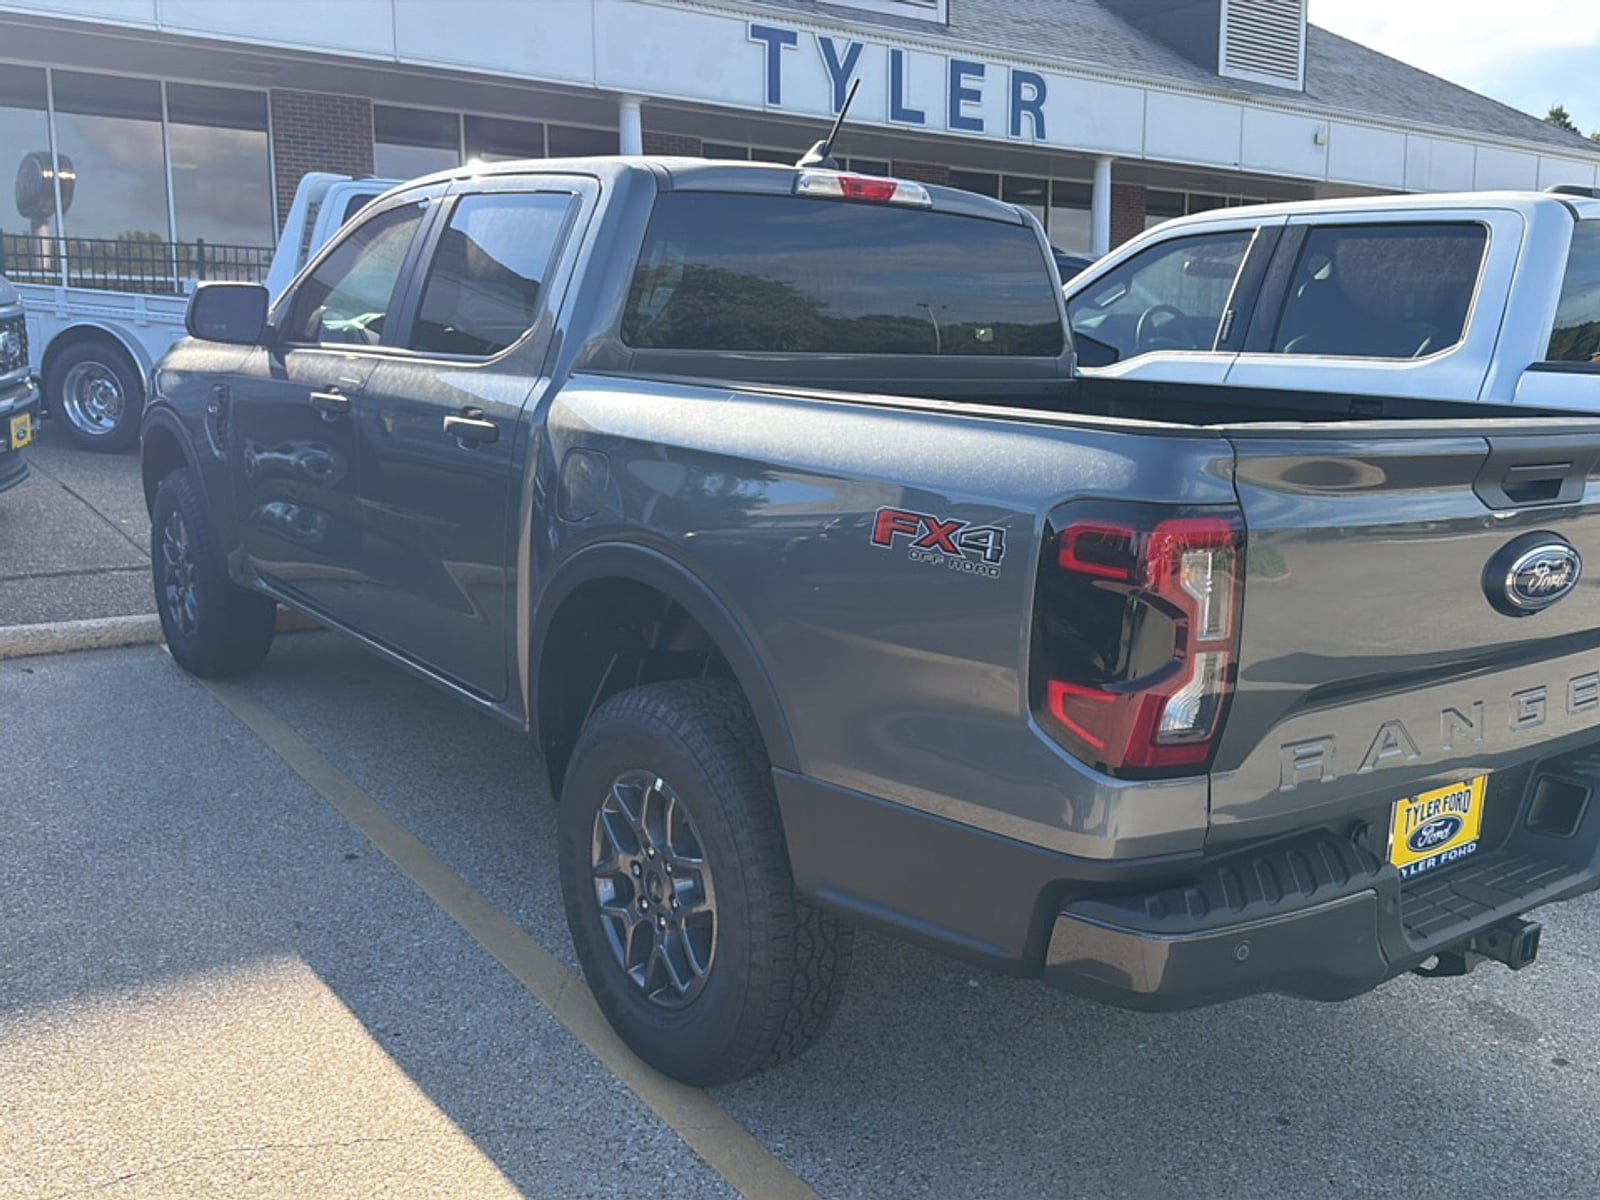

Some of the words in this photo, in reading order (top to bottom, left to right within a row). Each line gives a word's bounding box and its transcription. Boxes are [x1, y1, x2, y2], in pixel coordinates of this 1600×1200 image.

[749, 23, 1047, 140] TYLER
[871, 506, 1006, 565] FX4
[908, 550, 944, 564] OFF
[949, 558, 1000, 578] ROAD
[1521, 559, 1573, 594] Ford
[1405, 799, 1441, 834] TYLER
[1443, 789, 1471, 814] FORD
[1417, 820, 1453, 848] Ford
[1400, 858, 1436, 877] YLER
[1441, 842, 1477, 863] FORD
